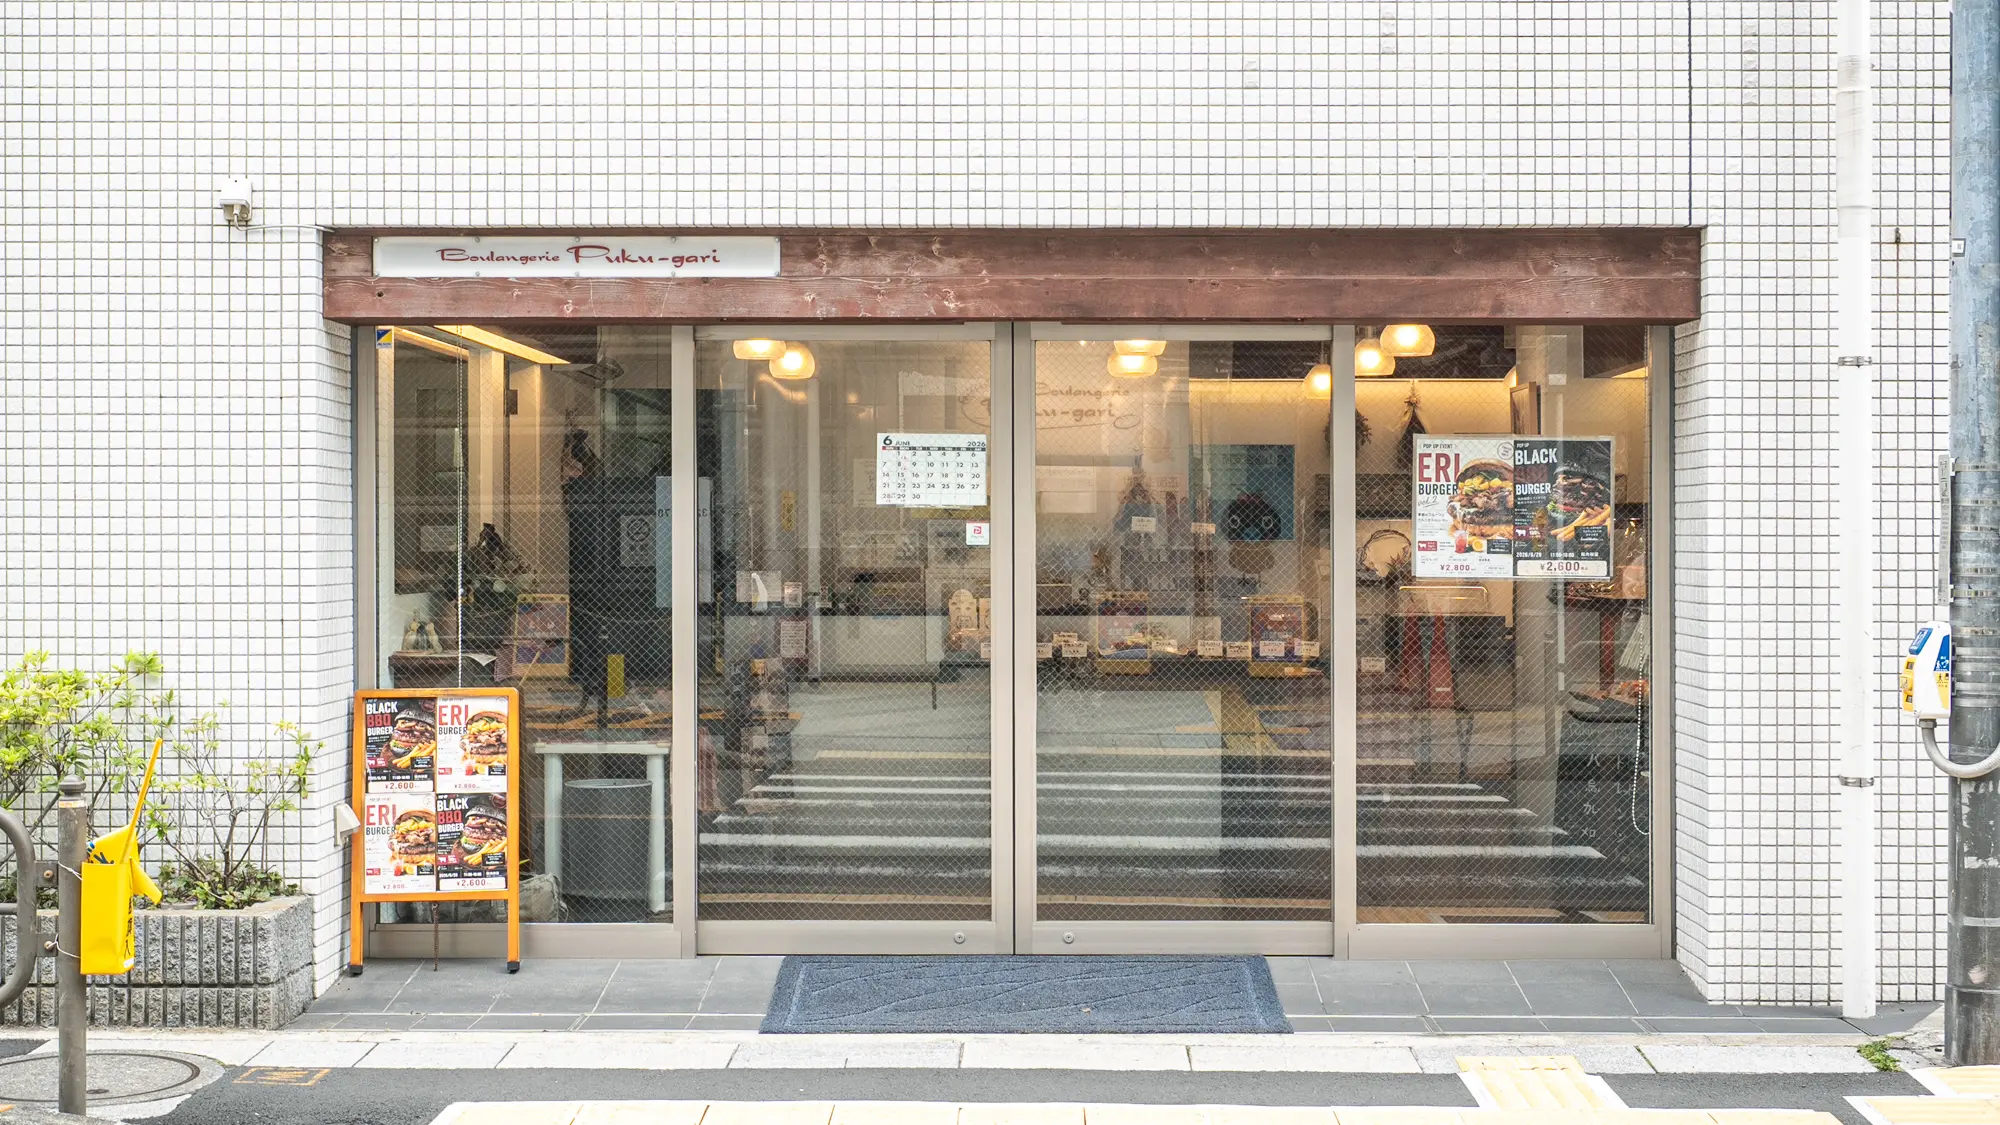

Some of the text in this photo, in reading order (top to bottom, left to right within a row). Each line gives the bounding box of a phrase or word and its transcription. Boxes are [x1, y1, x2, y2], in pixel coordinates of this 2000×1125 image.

[435, 245, 721, 269] Boulangerie Puku-gari
[883, 436, 892, 445] 6
[1515, 448, 1557, 465] BLACK
[1419, 453, 1460, 482] ERI
[1419, 484, 1458, 495] BURGER
[1516, 483, 1551, 495] BURGER
[1540, 562, 1580, 571] ¥2,600
[366, 701, 398, 714] BLACK
[367, 714, 391, 727] BBQ
[439, 705, 468, 725] ERI
[368, 726, 393, 736] BURGER
[439, 727, 467, 735] BURGER
[437, 798, 468, 811] BLACK
[366, 805, 396, 825] ERI
[438, 811, 462, 824] BBQ
[366, 827, 395, 835] BURGER
[438, 823, 464, 833] BURGER
